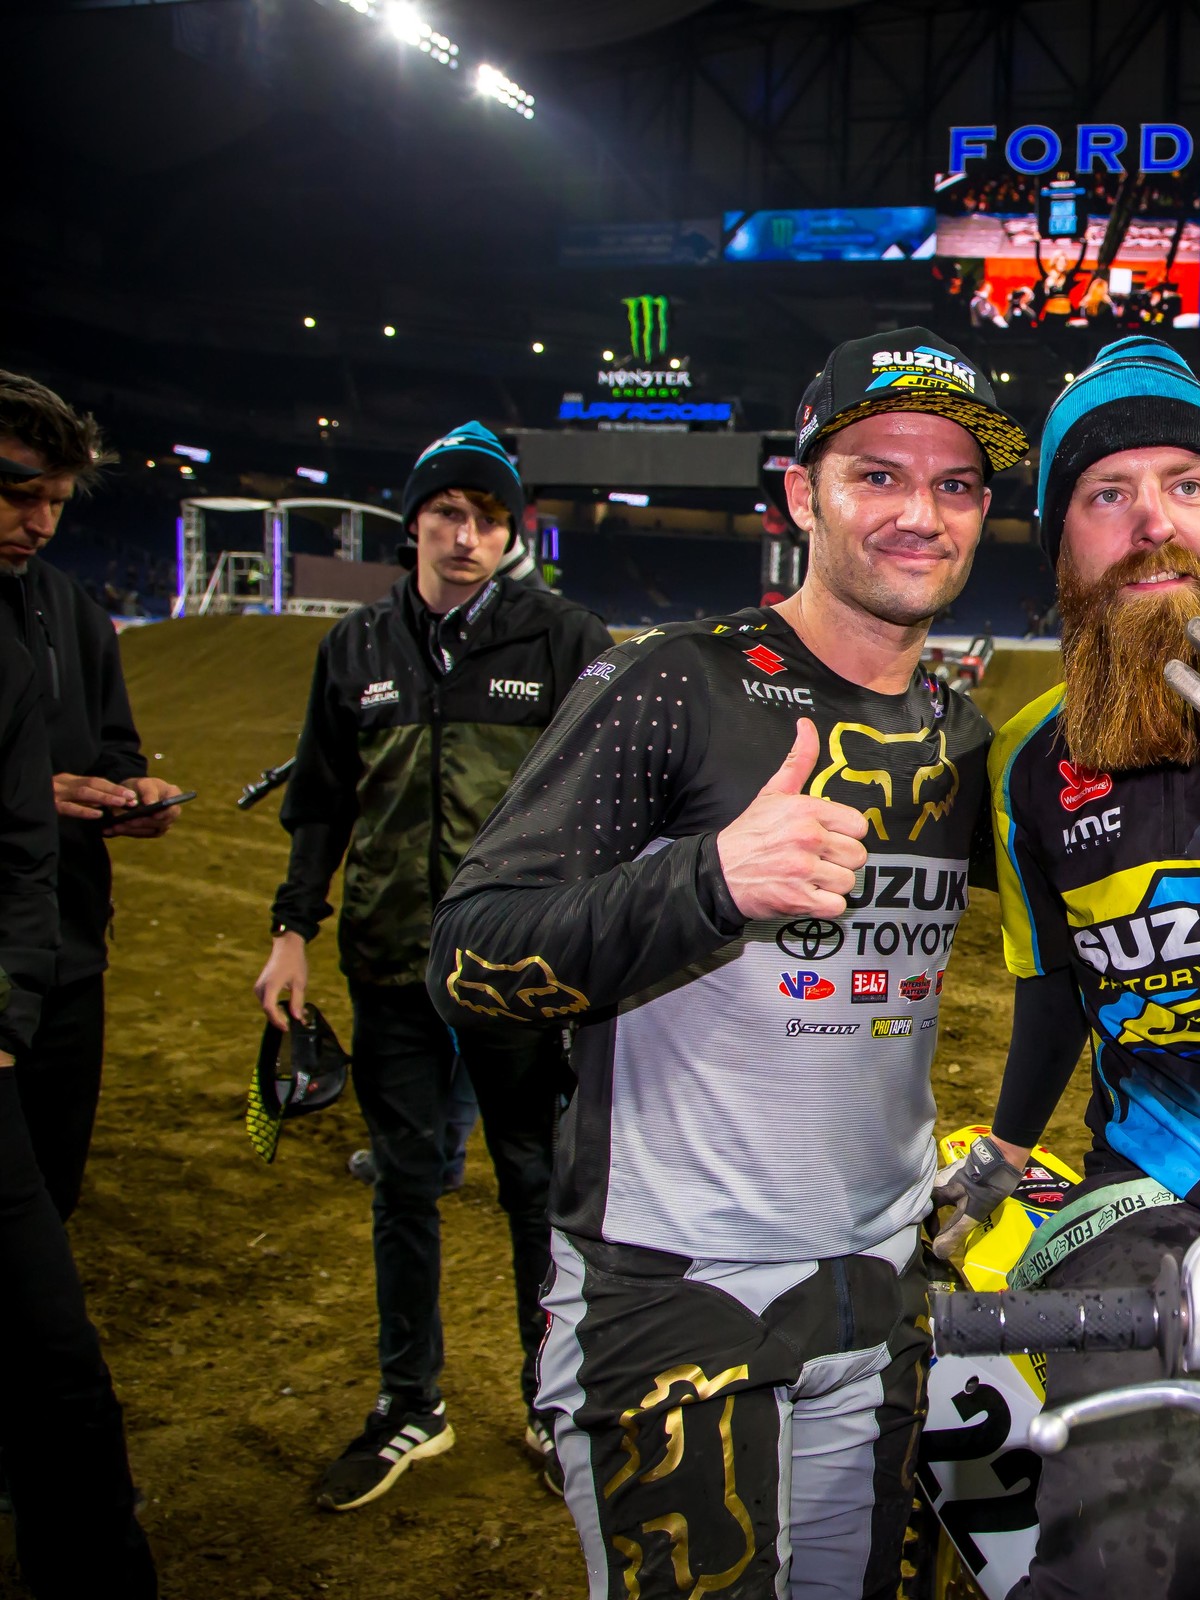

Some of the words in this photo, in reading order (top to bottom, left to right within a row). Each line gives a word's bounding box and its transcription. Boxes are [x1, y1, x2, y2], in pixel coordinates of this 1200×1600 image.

[948, 123, 1195, 175] FORD
[597, 369, 692, 388] MONSTER
[871, 364, 933, 374] FACTORY
[934, 369, 976, 394] RACING
[872, 350, 976, 387] SUZUKI
[490, 678, 541, 696] KMC
[741, 678, 814, 705] KMC
[1065, 831, 1121, 855] HEELS
[846, 865, 968, 911] UZUK
[780, 970, 820, 1000] VP
[853, 973, 887, 993] ヨシムラ
[800, 1023, 861, 1035] SCOTT
[873, 1018, 913, 1037] PROTAPER
[1110, 1194, 1147, 1220] FOX
[1063, 1220, 1094, 1252] FOX
[1030, 1247, 1053, 1276] FOX
